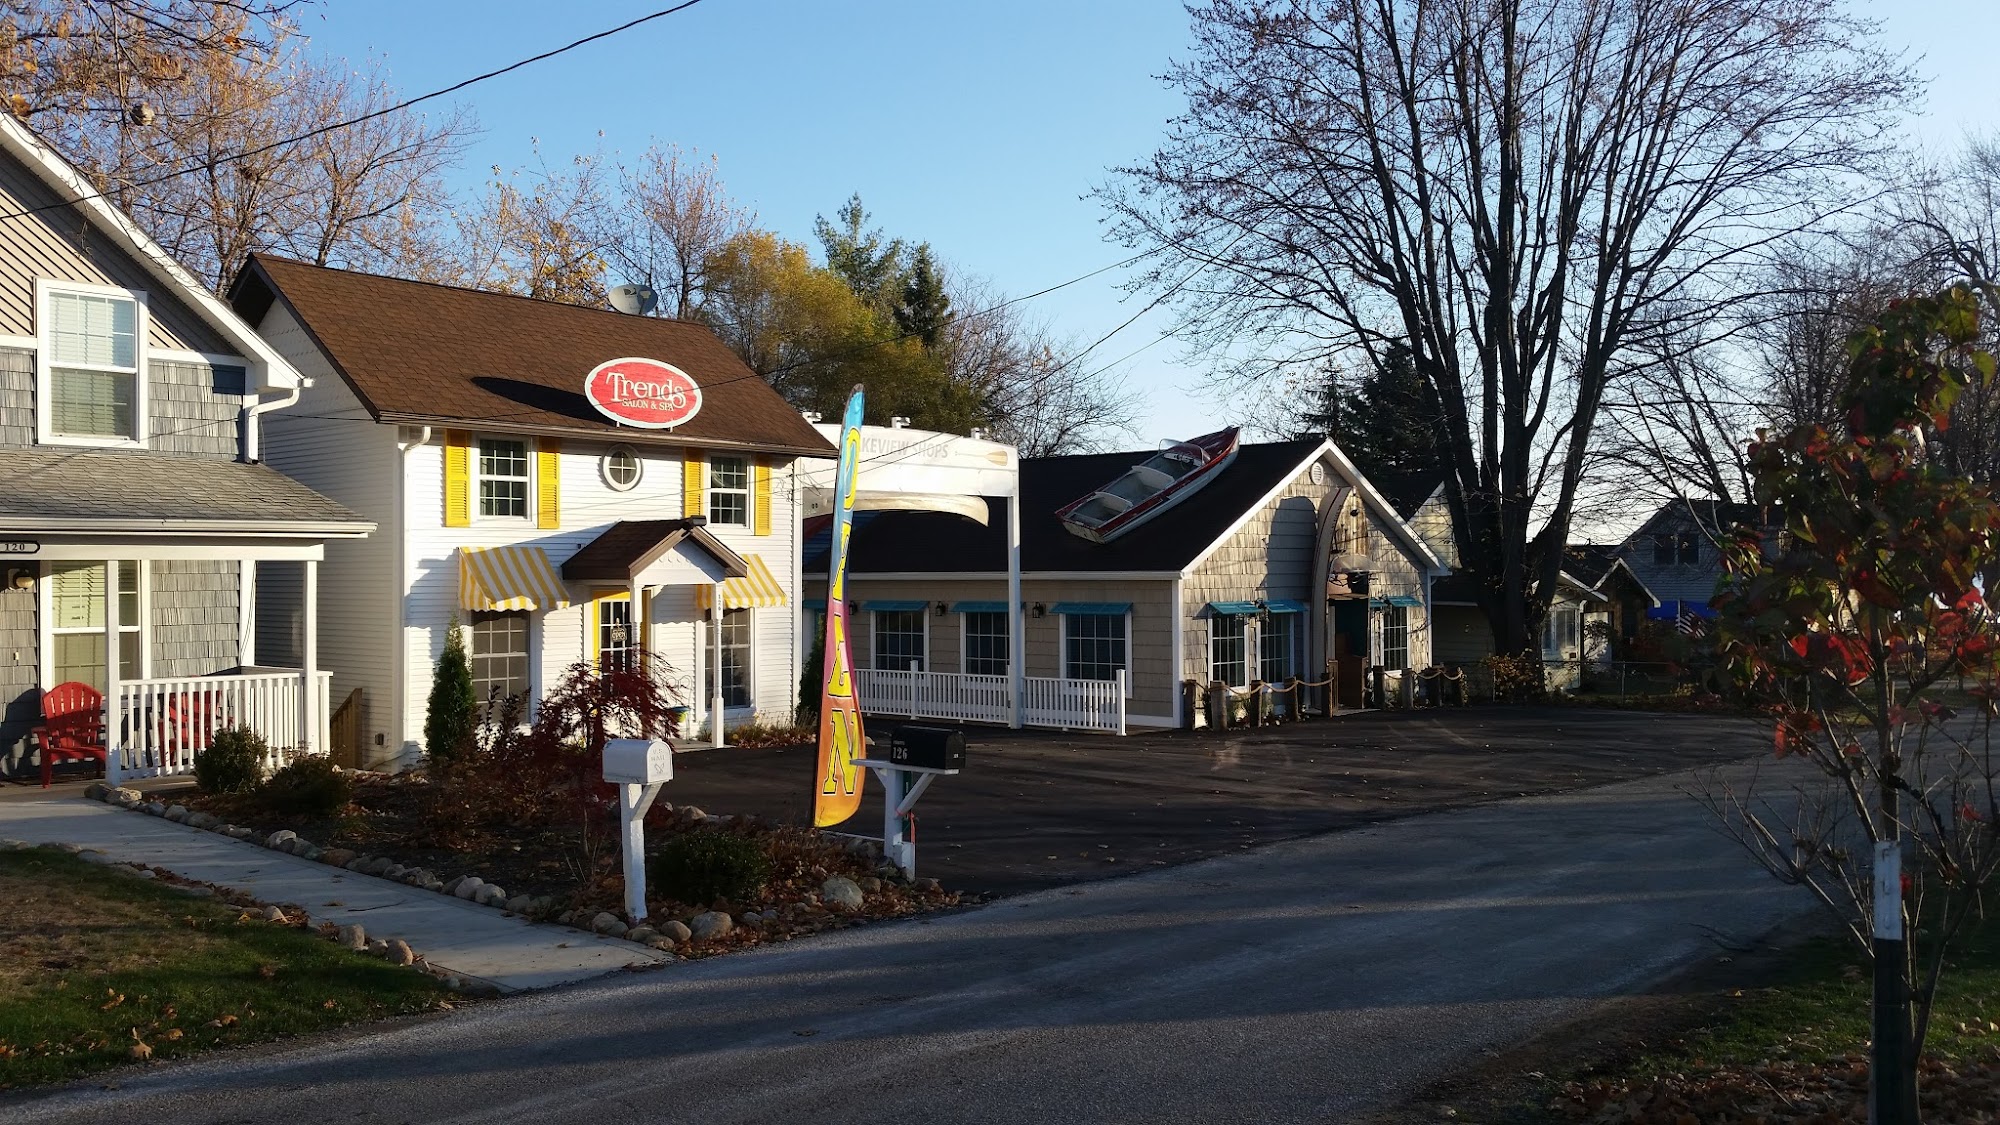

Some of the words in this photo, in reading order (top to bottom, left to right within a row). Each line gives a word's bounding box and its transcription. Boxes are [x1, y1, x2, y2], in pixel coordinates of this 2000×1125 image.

[606, 372, 686, 408] Trends
[622, 398, 648, 409] SALON
[650, 401, 657, 410] &
[659, 402, 674, 411] SPA
[861, 437, 908, 455] KEVIEW
[912, 442, 949, 458] SHOPS
[5, 543, 25, 551] 120
[893, 747, 908, 760] 126
